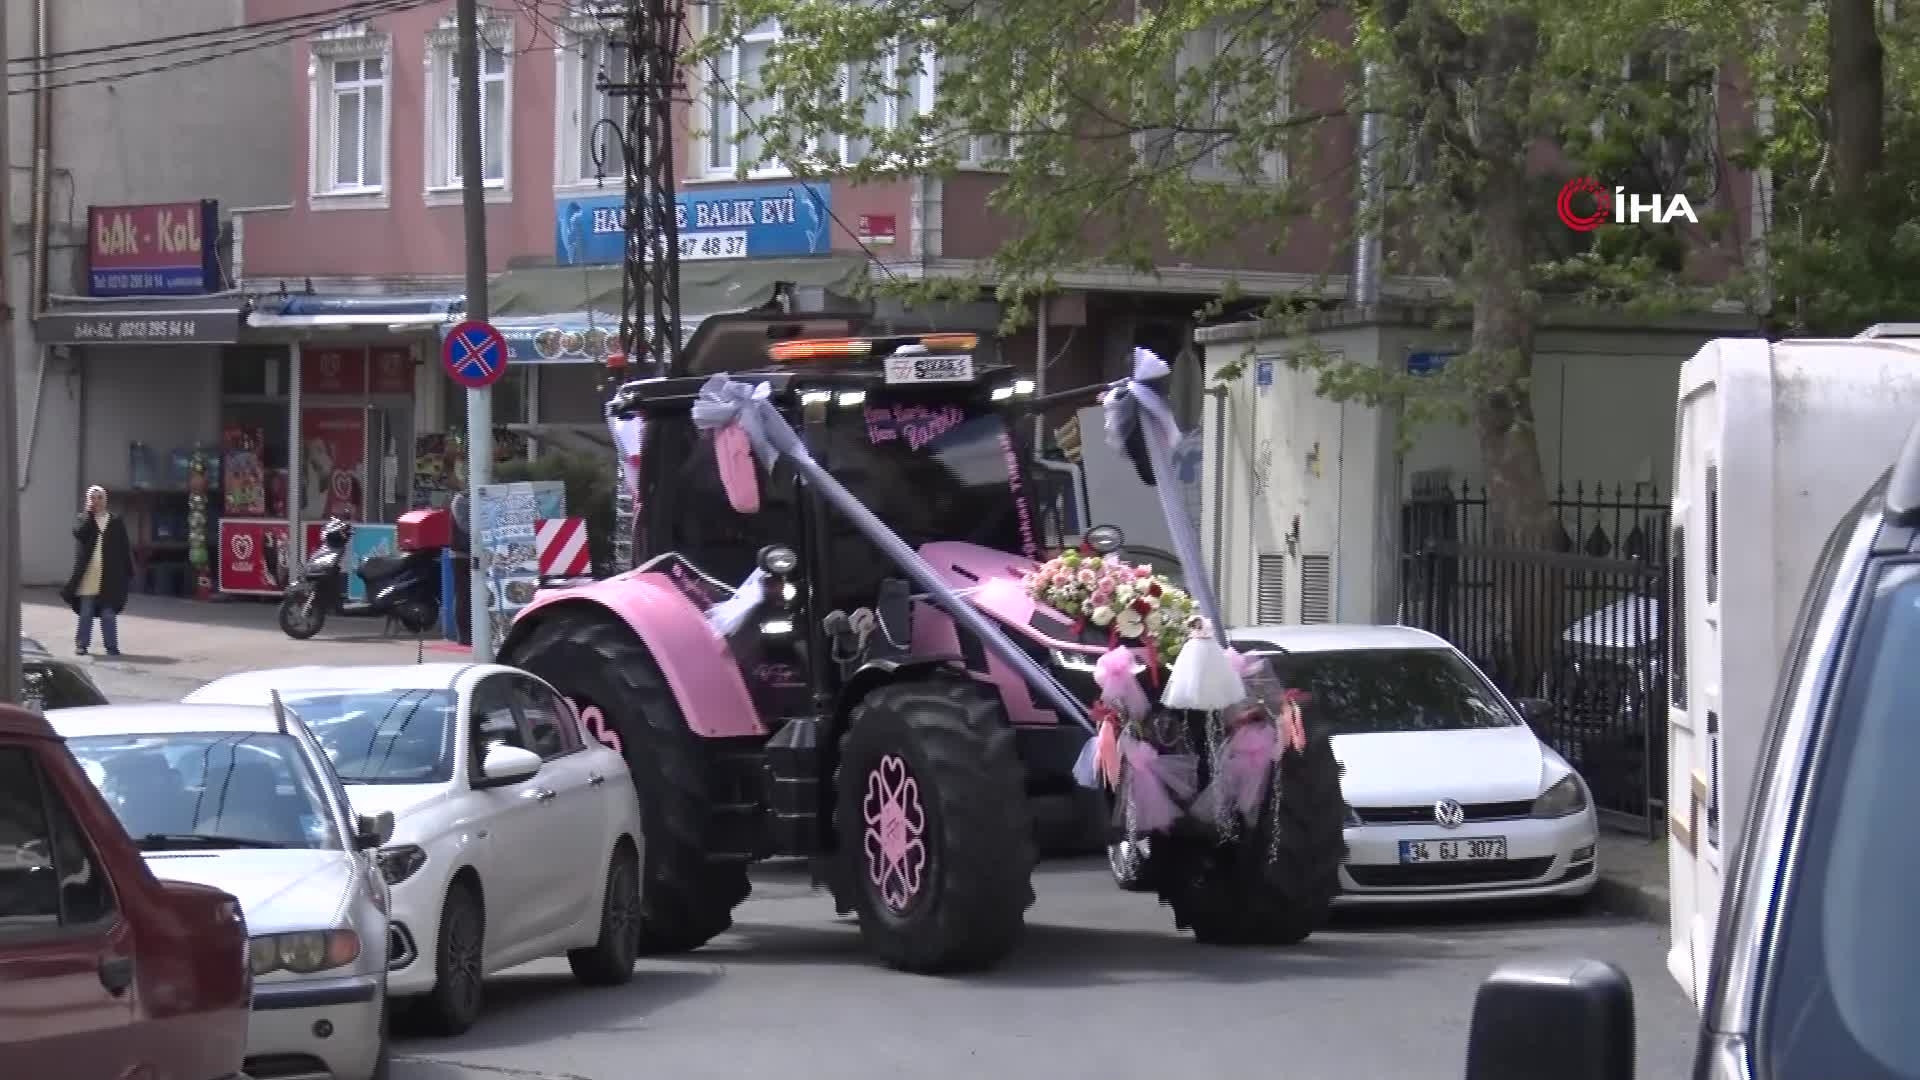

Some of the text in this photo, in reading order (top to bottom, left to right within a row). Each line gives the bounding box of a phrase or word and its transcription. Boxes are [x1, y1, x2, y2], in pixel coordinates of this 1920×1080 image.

[695, 200, 756, 227] BALIK
[760, 189, 796, 224] EVİ
[701, 236, 721, 254] 48
[725, 236, 744, 254] 37
[1410, 840, 1505, 861] 34 GJ 3072
